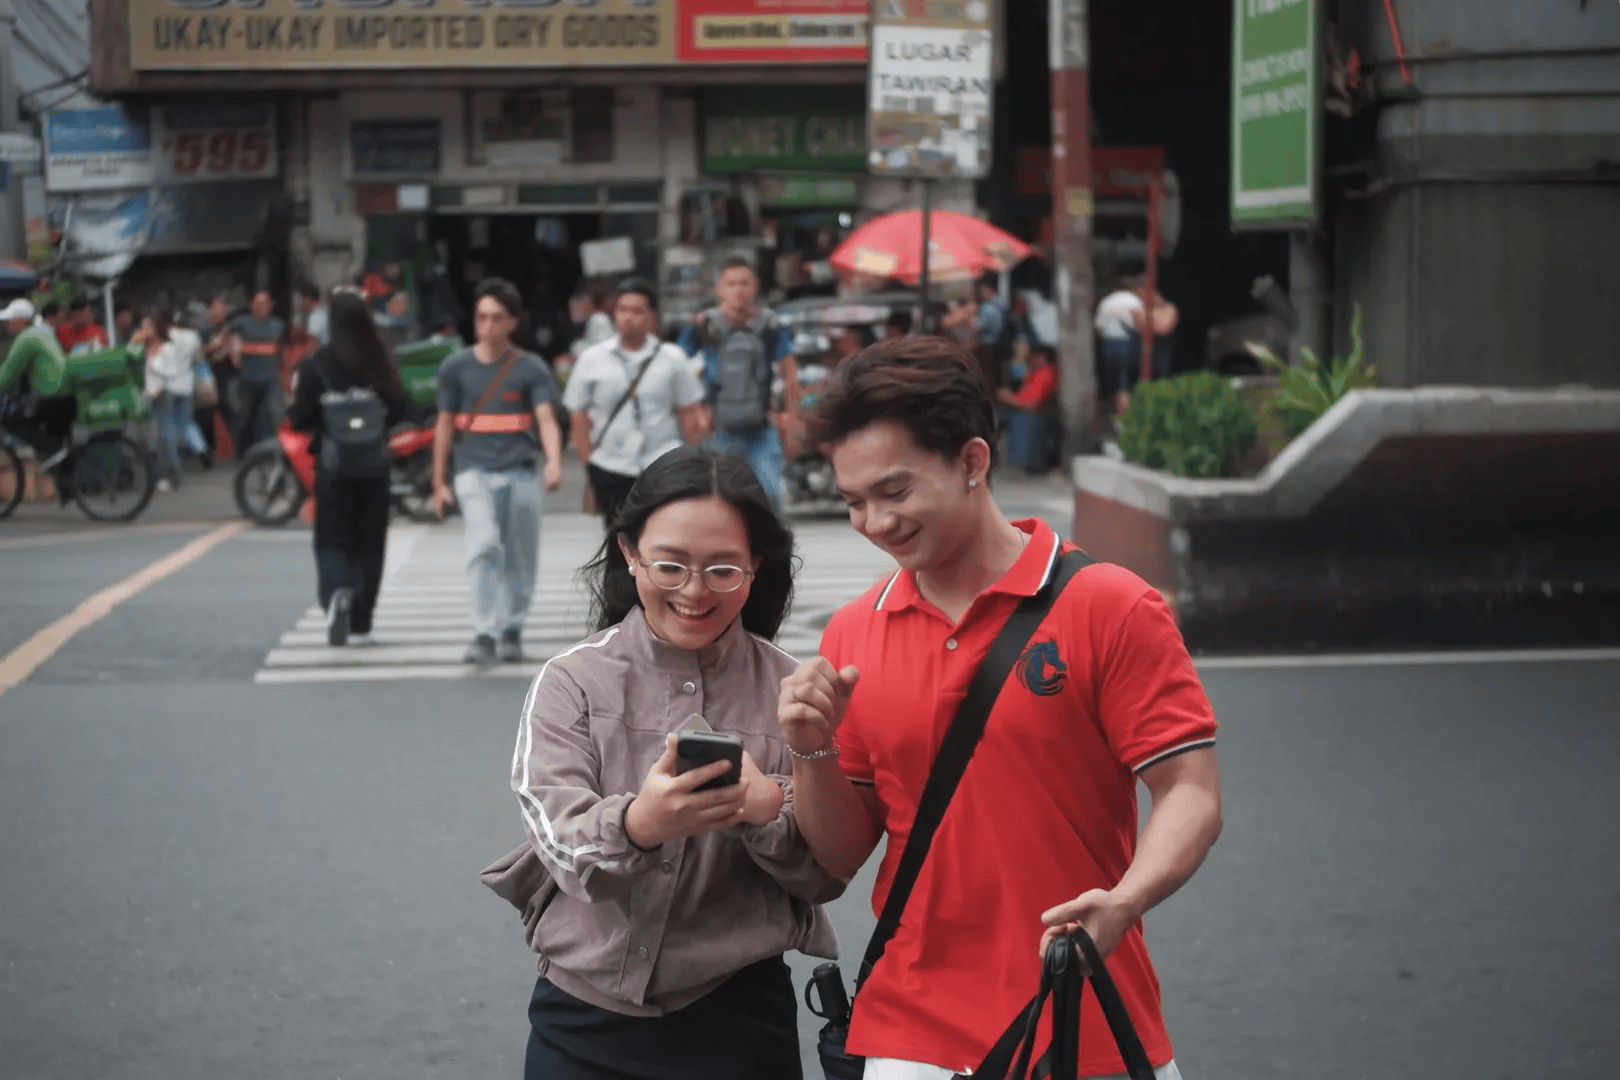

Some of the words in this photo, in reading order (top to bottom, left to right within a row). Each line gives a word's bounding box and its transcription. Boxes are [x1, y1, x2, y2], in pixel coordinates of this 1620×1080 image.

[153, 15, 325, 50] UKAY-UKAY
[334, 15, 484, 49] IMPORTED
[494, 14, 554, 49] DRY
[562, 14, 660, 49] GOODS
[884, 42, 971, 61] LUGAR
[873, 72, 989, 95] TAWIRAN
